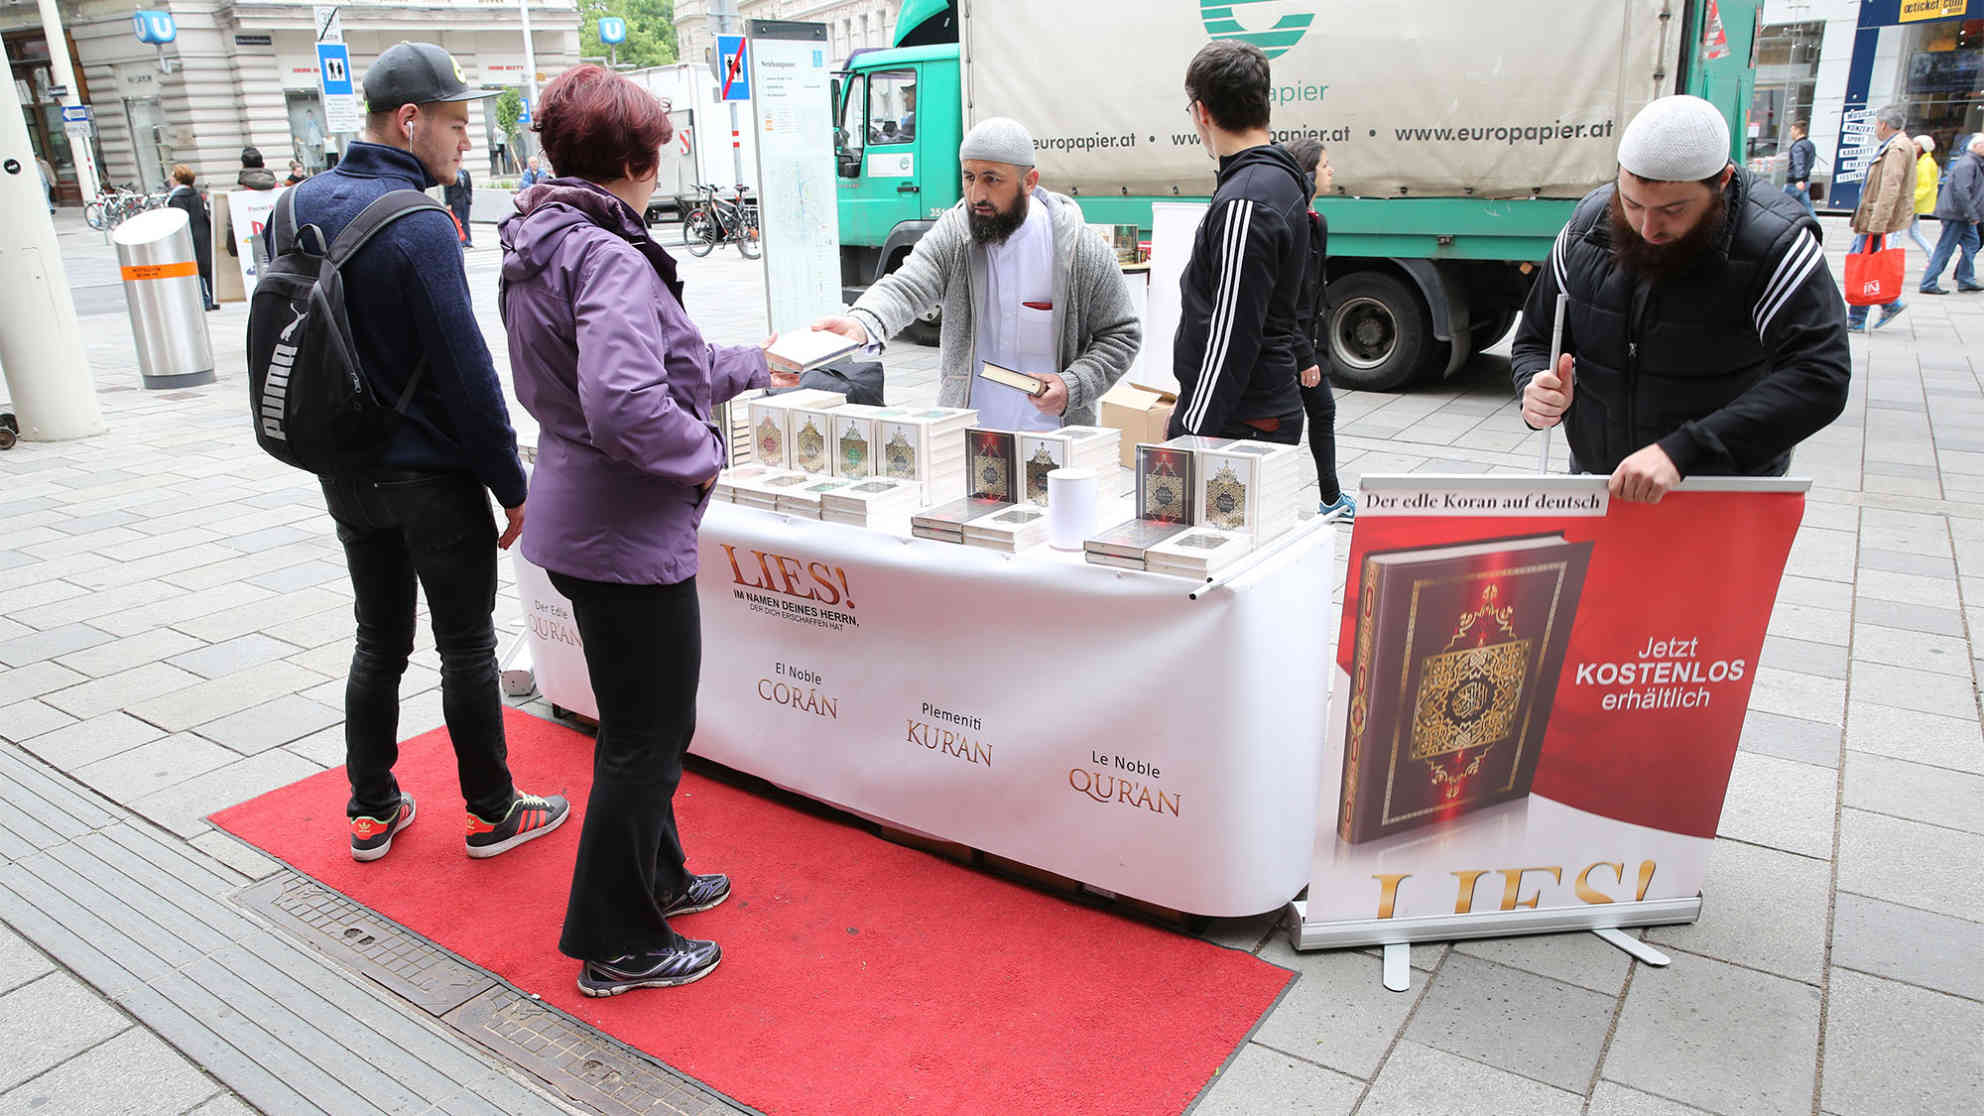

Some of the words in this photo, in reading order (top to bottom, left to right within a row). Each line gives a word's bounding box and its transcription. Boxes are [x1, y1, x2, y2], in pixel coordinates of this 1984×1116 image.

[152, 17, 172, 38] U
[606, 22, 620, 39] U
[1394, 119, 1614, 145] www.europapier.at
[1366, 494, 1398, 509] Der
[1402, 493, 1438, 509] edle
[1444, 493, 1497, 509] Koran
[1503, 493, 1533, 509] auf
[1535, 493, 1600, 509] deutsch
[720, 543, 855, 609] LIES!
[733, 589, 744, 600] IM
[746, 592, 779, 609] NAMEN
[782, 600, 818, 617] DEINES
[821, 608, 860, 628] HERRN,
[750, 603, 763, 612] DER
[764, 605, 780, 617] DICH
[781, 610, 829, 628] ERSCHAFFEN
[829, 621, 843, 632] HAT
[1638, 636, 1698, 659] Jetzt
[775, 662, 785, 674] El
[789, 665, 822, 685] Noble
[1576, 659, 1745, 685] KOSTENLOS
[758, 678, 839, 720] CORÁN
[1601, 686, 1711, 711] erhältlich
[922, 702, 981, 731] Plemeniti
[1092, 750, 1109, 766] Le
[1115, 755, 1160, 779] Noble
